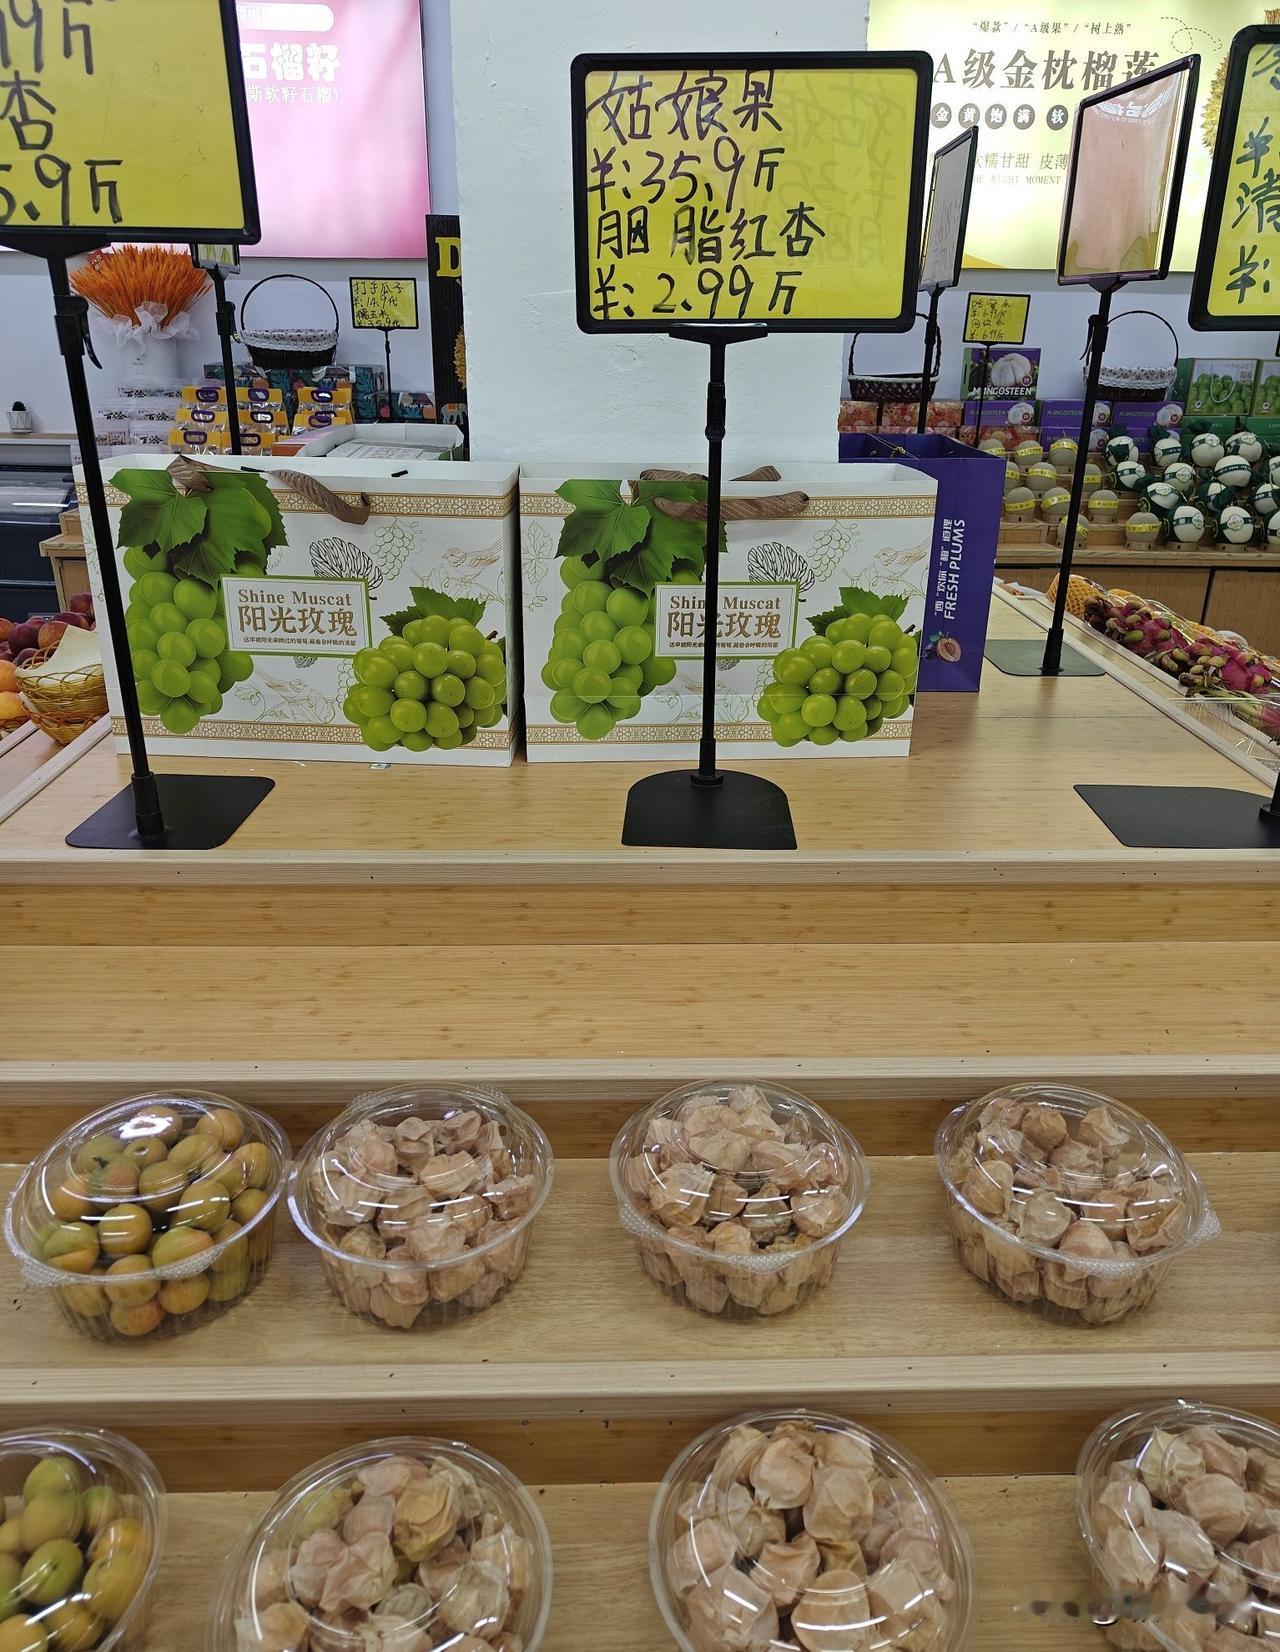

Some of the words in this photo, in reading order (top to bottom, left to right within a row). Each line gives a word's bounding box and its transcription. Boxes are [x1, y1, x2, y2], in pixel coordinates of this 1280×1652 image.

[586, 68, 783, 145] 姑娘果
[949, 518, 966, 570] PLUMS
[238, 589, 285, 604] Shine
[291, 590, 352, 606] Muscat
[670, 595, 705, 609] Shin
[723, 596, 780, 609] Muscat
[944, 573, 960, 620] FRESH
[238, 605, 357, 636] 阳光玫瑰
